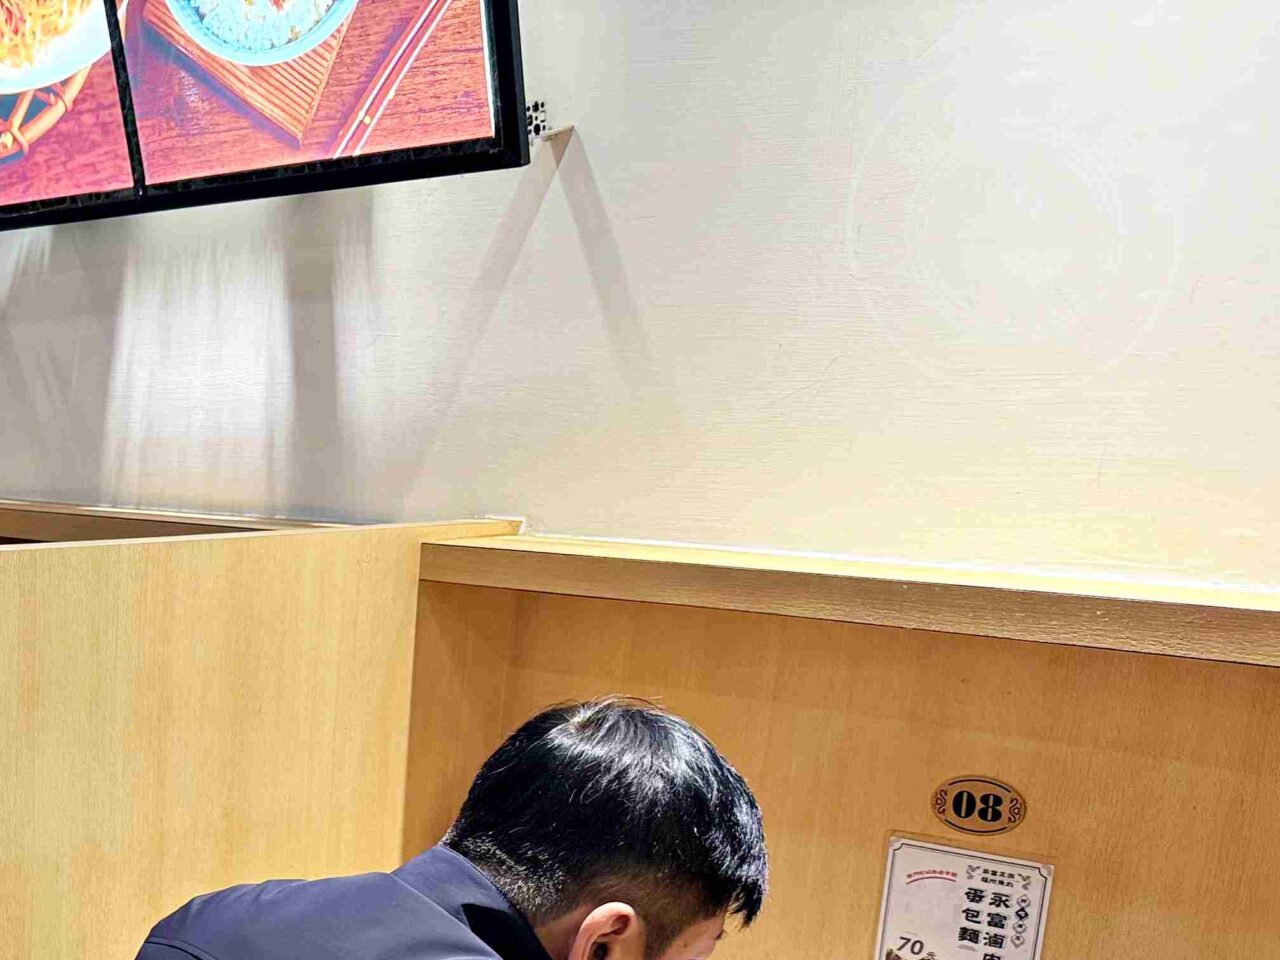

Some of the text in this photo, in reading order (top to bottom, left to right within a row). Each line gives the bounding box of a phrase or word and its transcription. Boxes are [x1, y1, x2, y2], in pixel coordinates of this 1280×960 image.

[952, 790, 1003, 822] 08
[958, 887, 986, 944] 蛋包麵
[896, 936, 924, 955] 70
